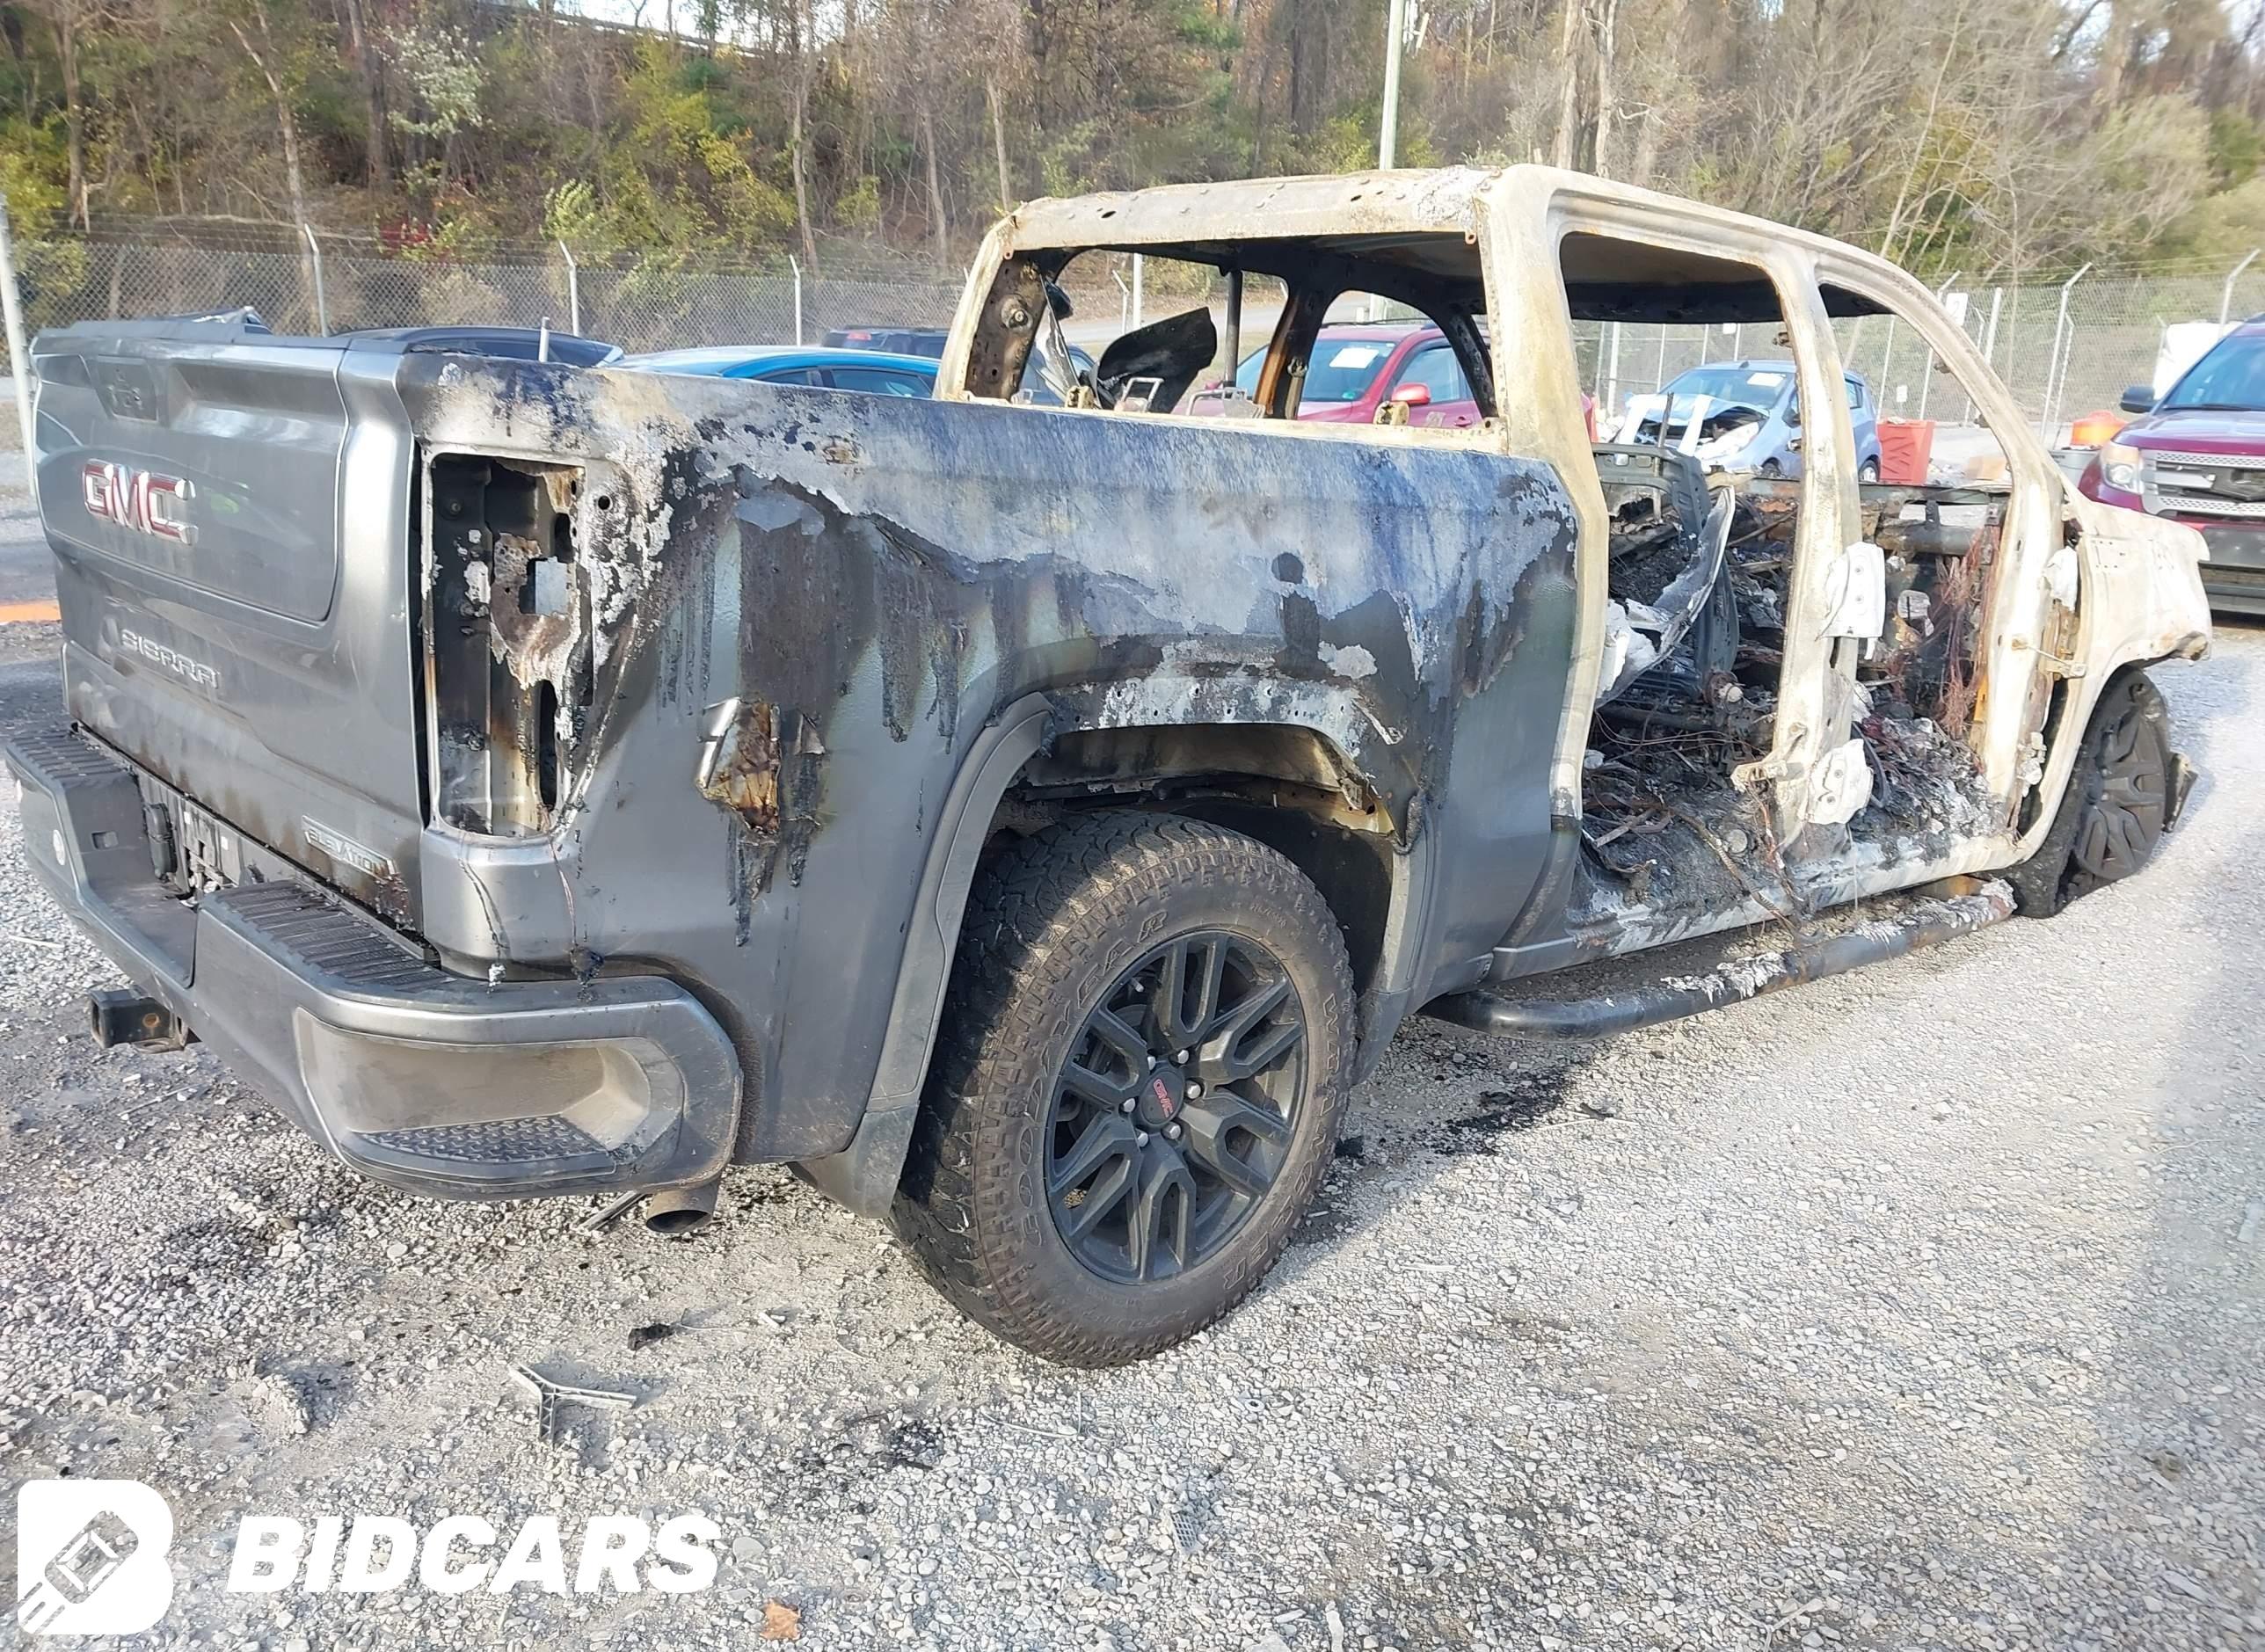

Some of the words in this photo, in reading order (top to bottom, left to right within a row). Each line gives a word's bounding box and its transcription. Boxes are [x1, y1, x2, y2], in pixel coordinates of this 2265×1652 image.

[82, 458, 199, 546] GMC
[121, 629, 220, 689] SIERRA
[1018, 909, 1168, 1247] GOODYEAR
[1153, 1078, 1174, 1118] GMC
[1223, 993, 1341, 1291] WRANGLER
